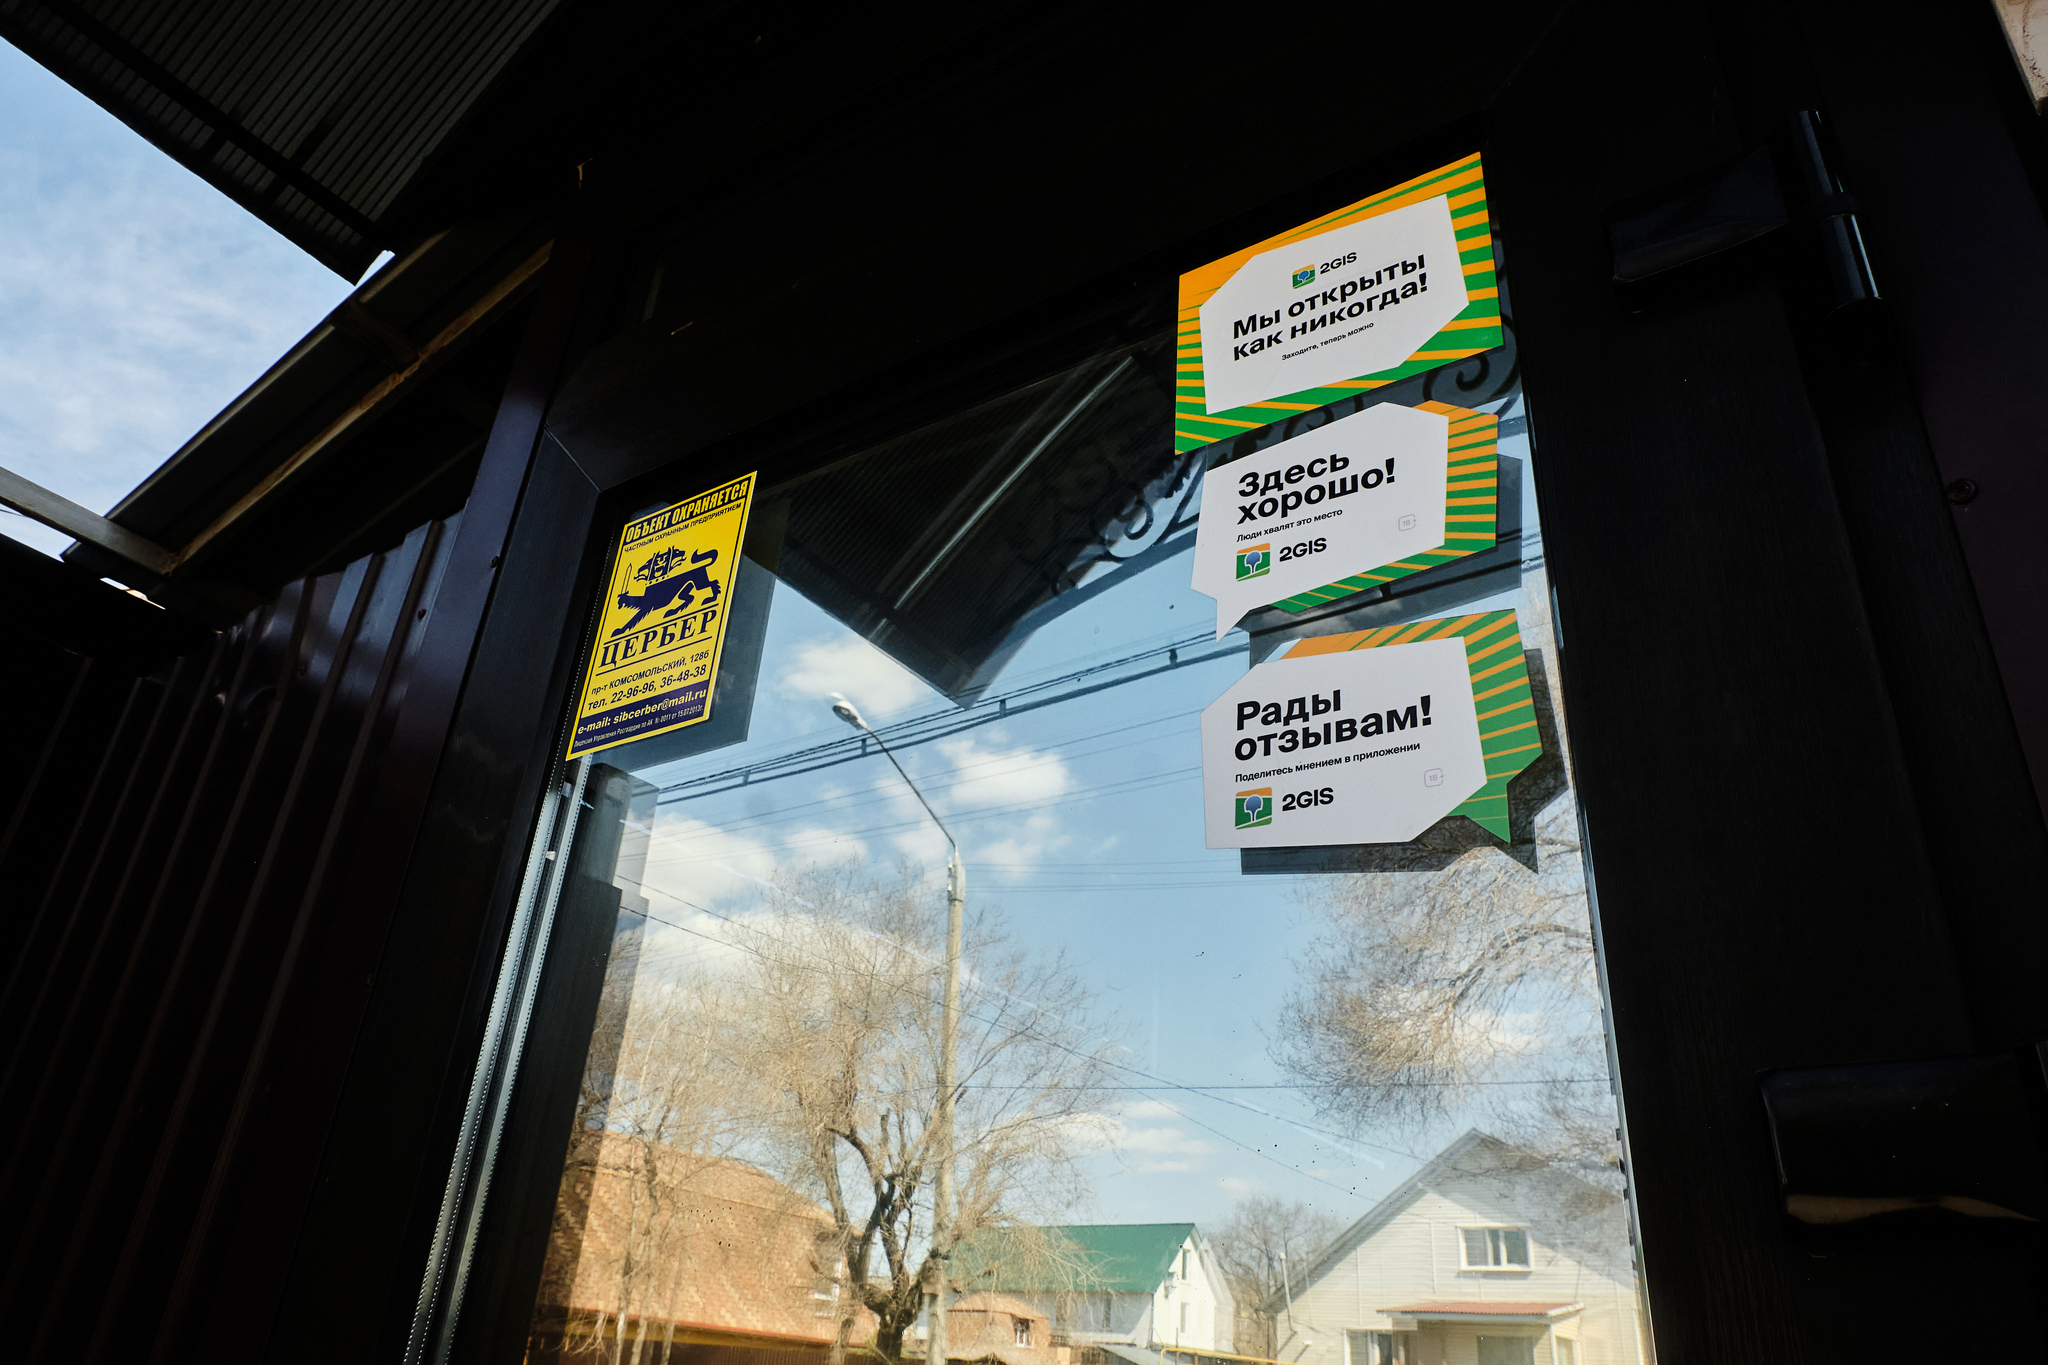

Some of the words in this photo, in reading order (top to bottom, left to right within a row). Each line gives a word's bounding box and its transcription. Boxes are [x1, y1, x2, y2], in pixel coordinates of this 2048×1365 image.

[1320, 251, 1358, 275] 2GIS
[1233, 309, 1280, 340] Мы
[1288, 254, 1427, 319] открыты
[1233, 329, 1283, 362] как
[1290, 272, 1428, 340] никогда!
[1281, 344, 1319, 361] Заходите,
[1319, 332, 1347, 349] теперь
[1347, 321, 1375, 338] можно
[1236, 457, 1396, 526] хорошо!
[1238, 454, 1350, 498] Здесь
[624, 537, 654, 552] ЧАСТНЫМ
[654, 523, 689, 541] ОХРАННЫМ
[690, 502, 742, 527] ПРЕДПРИЯТИЕМ
[625, 512, 672, 543] ОБЪЕКТ
[672, 480, 749, 524] ОХРАНЯЕТСЯ
[1236, 529, 1262, 543] Люди
[1264, 521, 1295, 536] хвалят
[1296, 516, 1312, 528] это
[1313, 508, 1343, 523] место
[1279, 537, 1327, 562] 2GIS
[598, 609, 717, 668] ЦЕРБЕР
[588, 699, 608, 711] тел.
[610, 682, 657, 704] 22-96-96,
[660, 664, 707, 688] 36-48-38
[591, 684, 608, 696] пр-т
[609, 656, 687, 689] КОМСОМОЛЬСКИЙ,
[577, 718, 611, 735] e-mail:
[613, 688, 707, 724] sibcerber@mail.ru
[1234, 695, 1432, 761] отзывам!
[1236, 689, 1341, 732] Рады
[1235, 765, 1293, 783] Поделитесь
[1294, 755, 1342, 773] мнением
[1344, 755, 1351, 764] в
[1352, 741, 1421, 763] приложении
[1282, 787, 1334, 812] 2GIS
